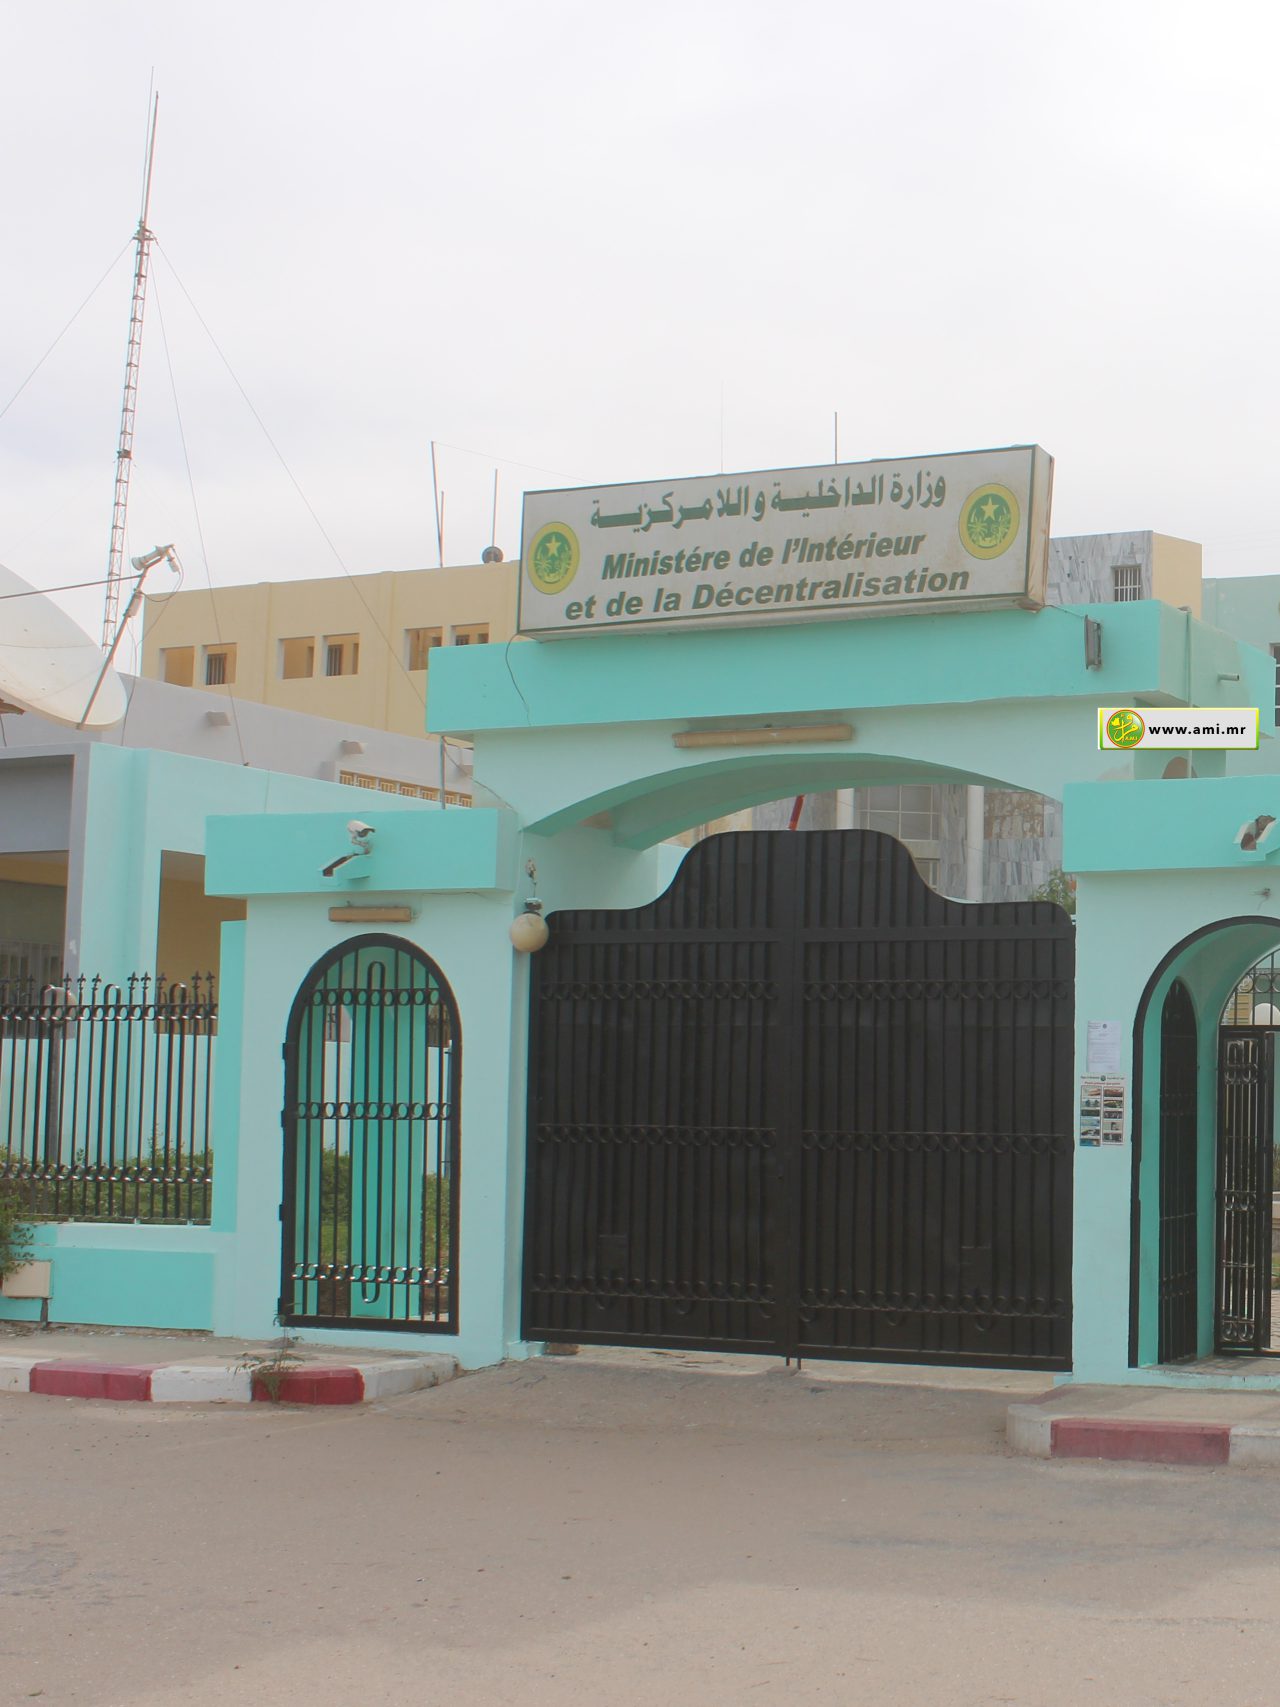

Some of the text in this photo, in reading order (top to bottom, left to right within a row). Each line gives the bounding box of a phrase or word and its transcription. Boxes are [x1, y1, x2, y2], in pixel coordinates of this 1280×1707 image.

[771, 473, 884, 518] الداخلية
[890, 470, 946, 510] وزارة
[601, 546, 731, 581] Ministére
[739, 541, 775, 569] de
[565, 568, 970, 621] et de la Décentralisation
